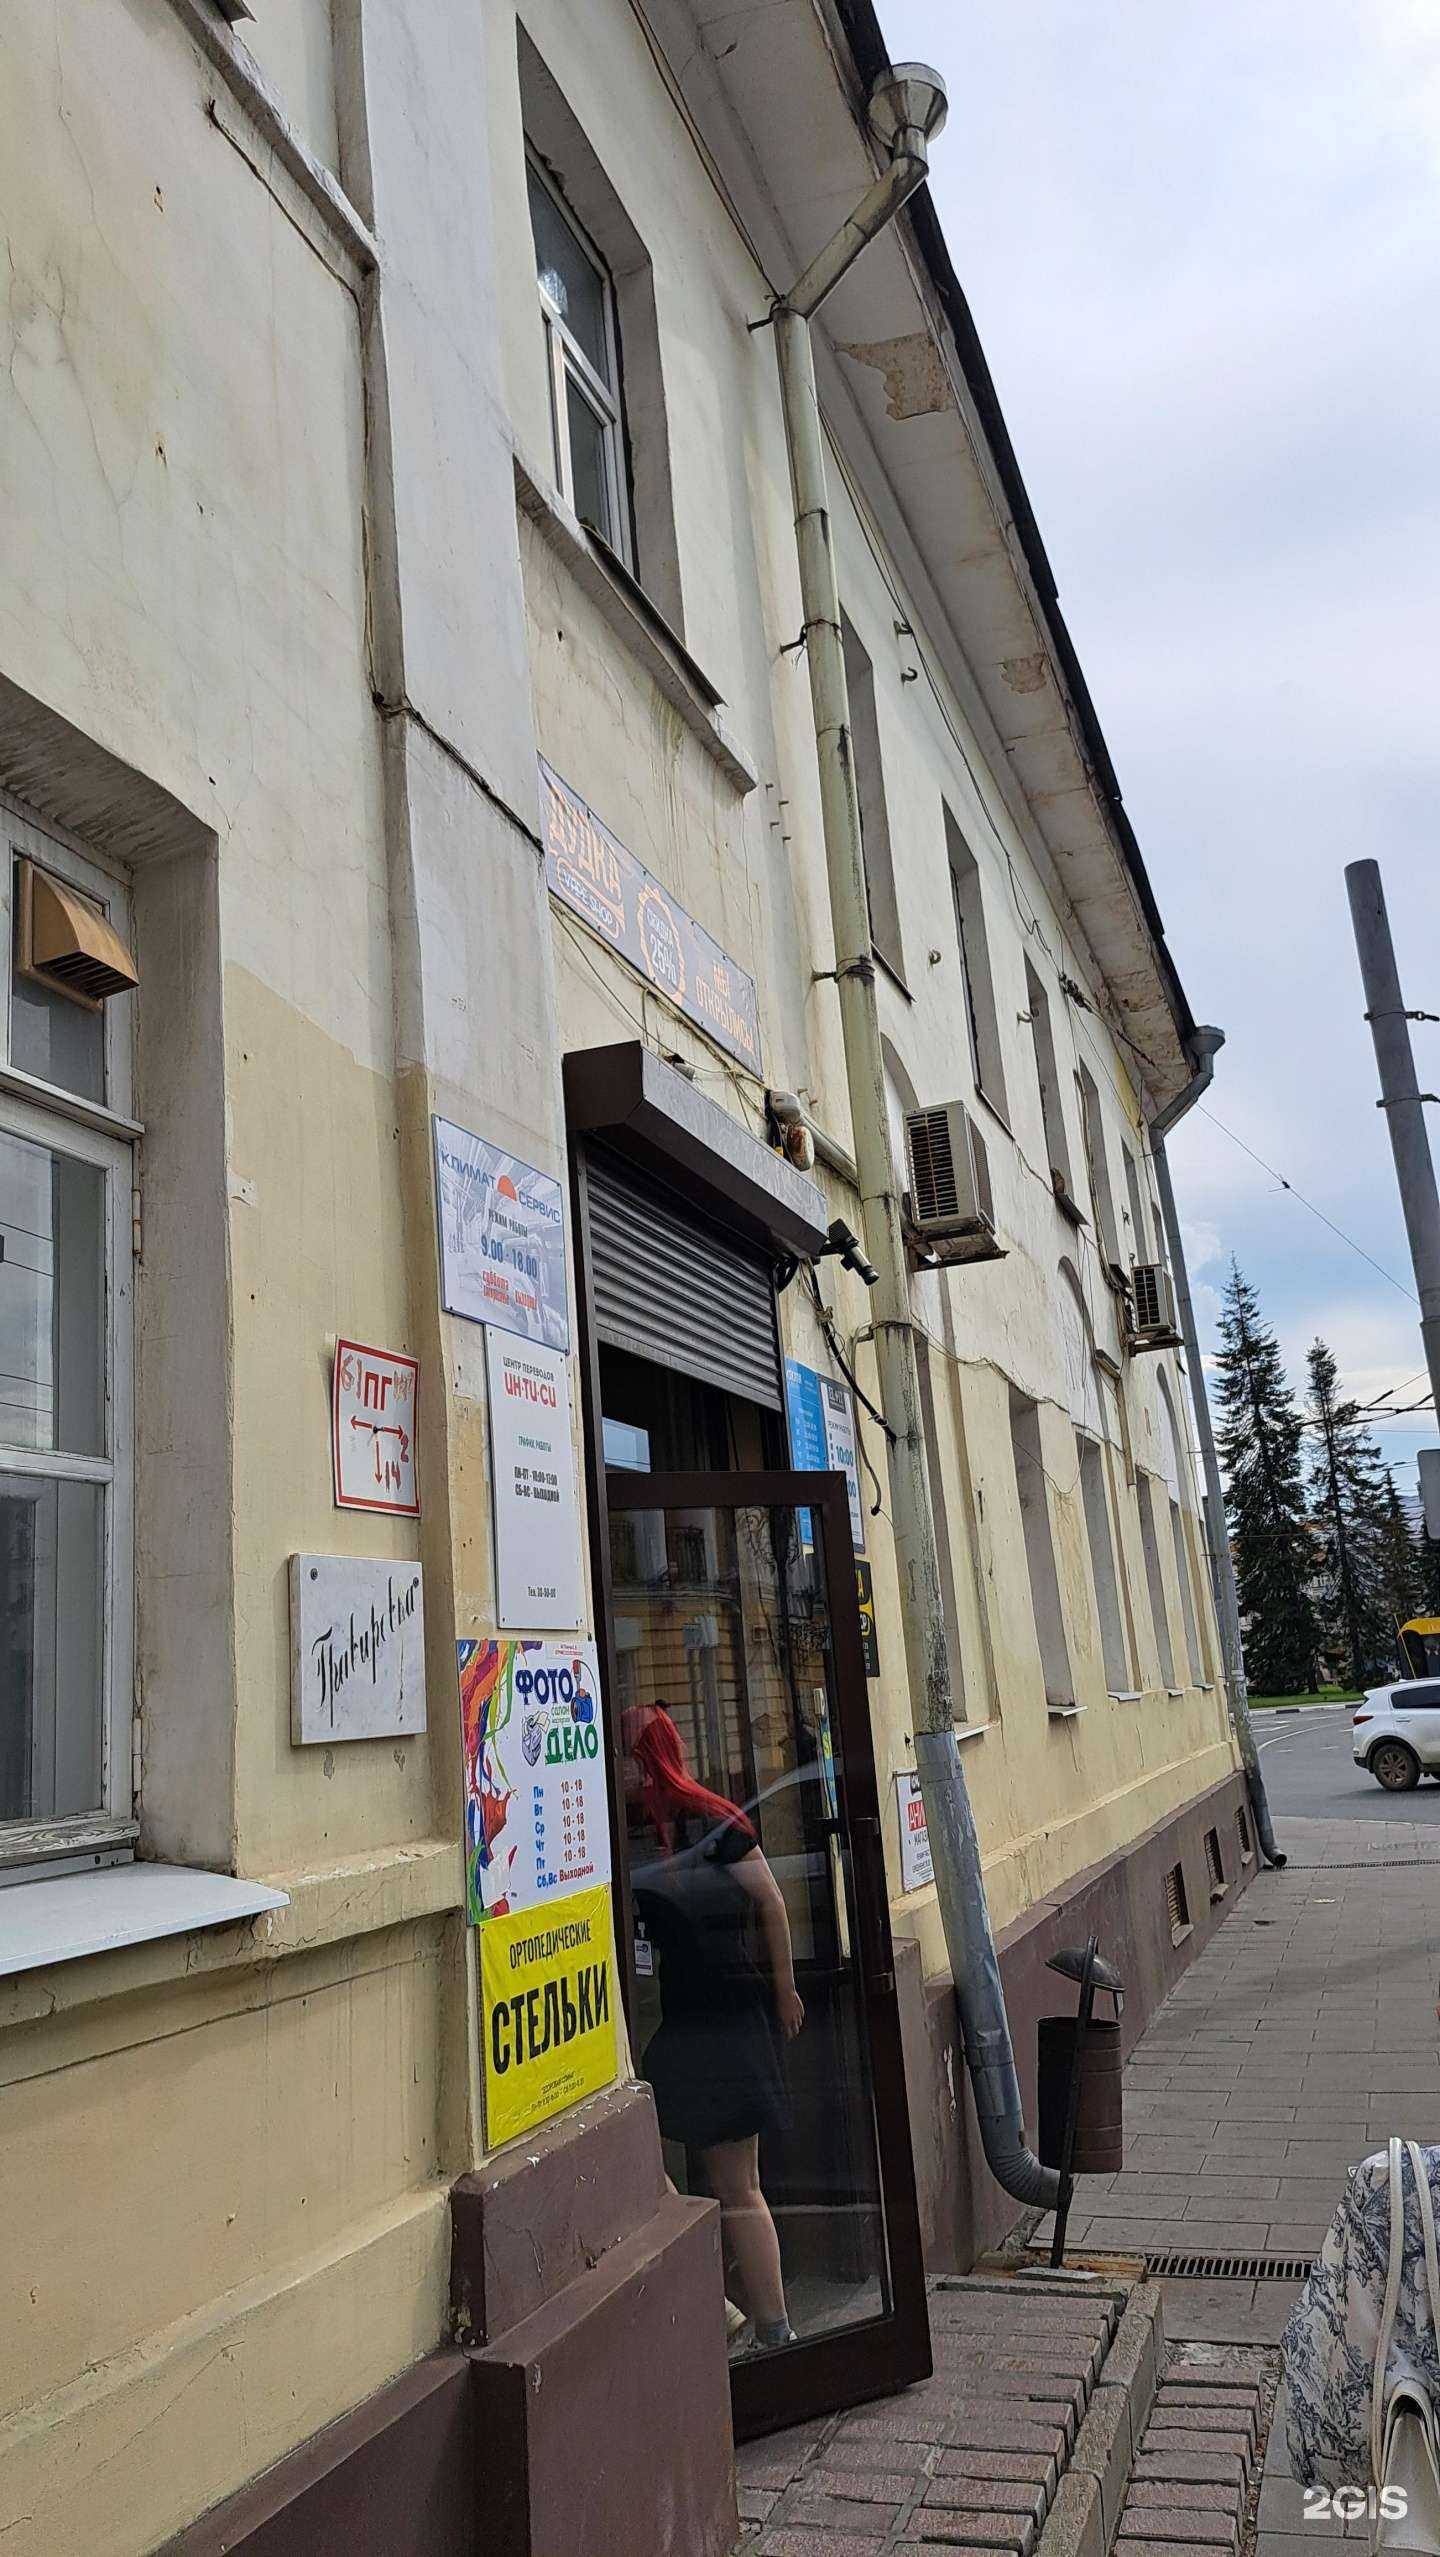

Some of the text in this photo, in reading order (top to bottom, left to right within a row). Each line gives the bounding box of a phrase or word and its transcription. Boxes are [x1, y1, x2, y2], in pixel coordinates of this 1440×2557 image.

[441, 1150, 561, 1224] КЛИМАТ СЕРВИС
[480, 1235, 503, 1263] 9.00
[511, 1248, 537, 1279] 18.00
[503, 1356, 554, 1382] ЦЕНТР ПЕРЕВОДОВ
[364, 1372, 393, 1411] ПГ
[385, 1460, 400, 1491] 14
[515, 1668, 573, 1706] ФОТО
[545, 1724, 599, 1766] ДЕЛО
[533, 1786, 544, 1799] Пн
[561, 1781, 569, 1794] 10
[534, 1804, 543, 1816] Вт
[562, 1798, 570, 1811] 10
[535, 1822, 545, 1837] Ср
[563, 1816, 571, 1828] 10
[536, 1840, 545, 1853] Чт
[563, 1833, 572, 1845] 10
[536, 1857, 545, 1871] Пт
[564, 1850, 572, 1863] 10
[559, 1862, 594, 1882] Выходной
[509, 1919, 591, 1969] ОРТОПЕДИЧЕСКИЕ
[491, 1961, 609, 2075] СТЕЛЬКИ
